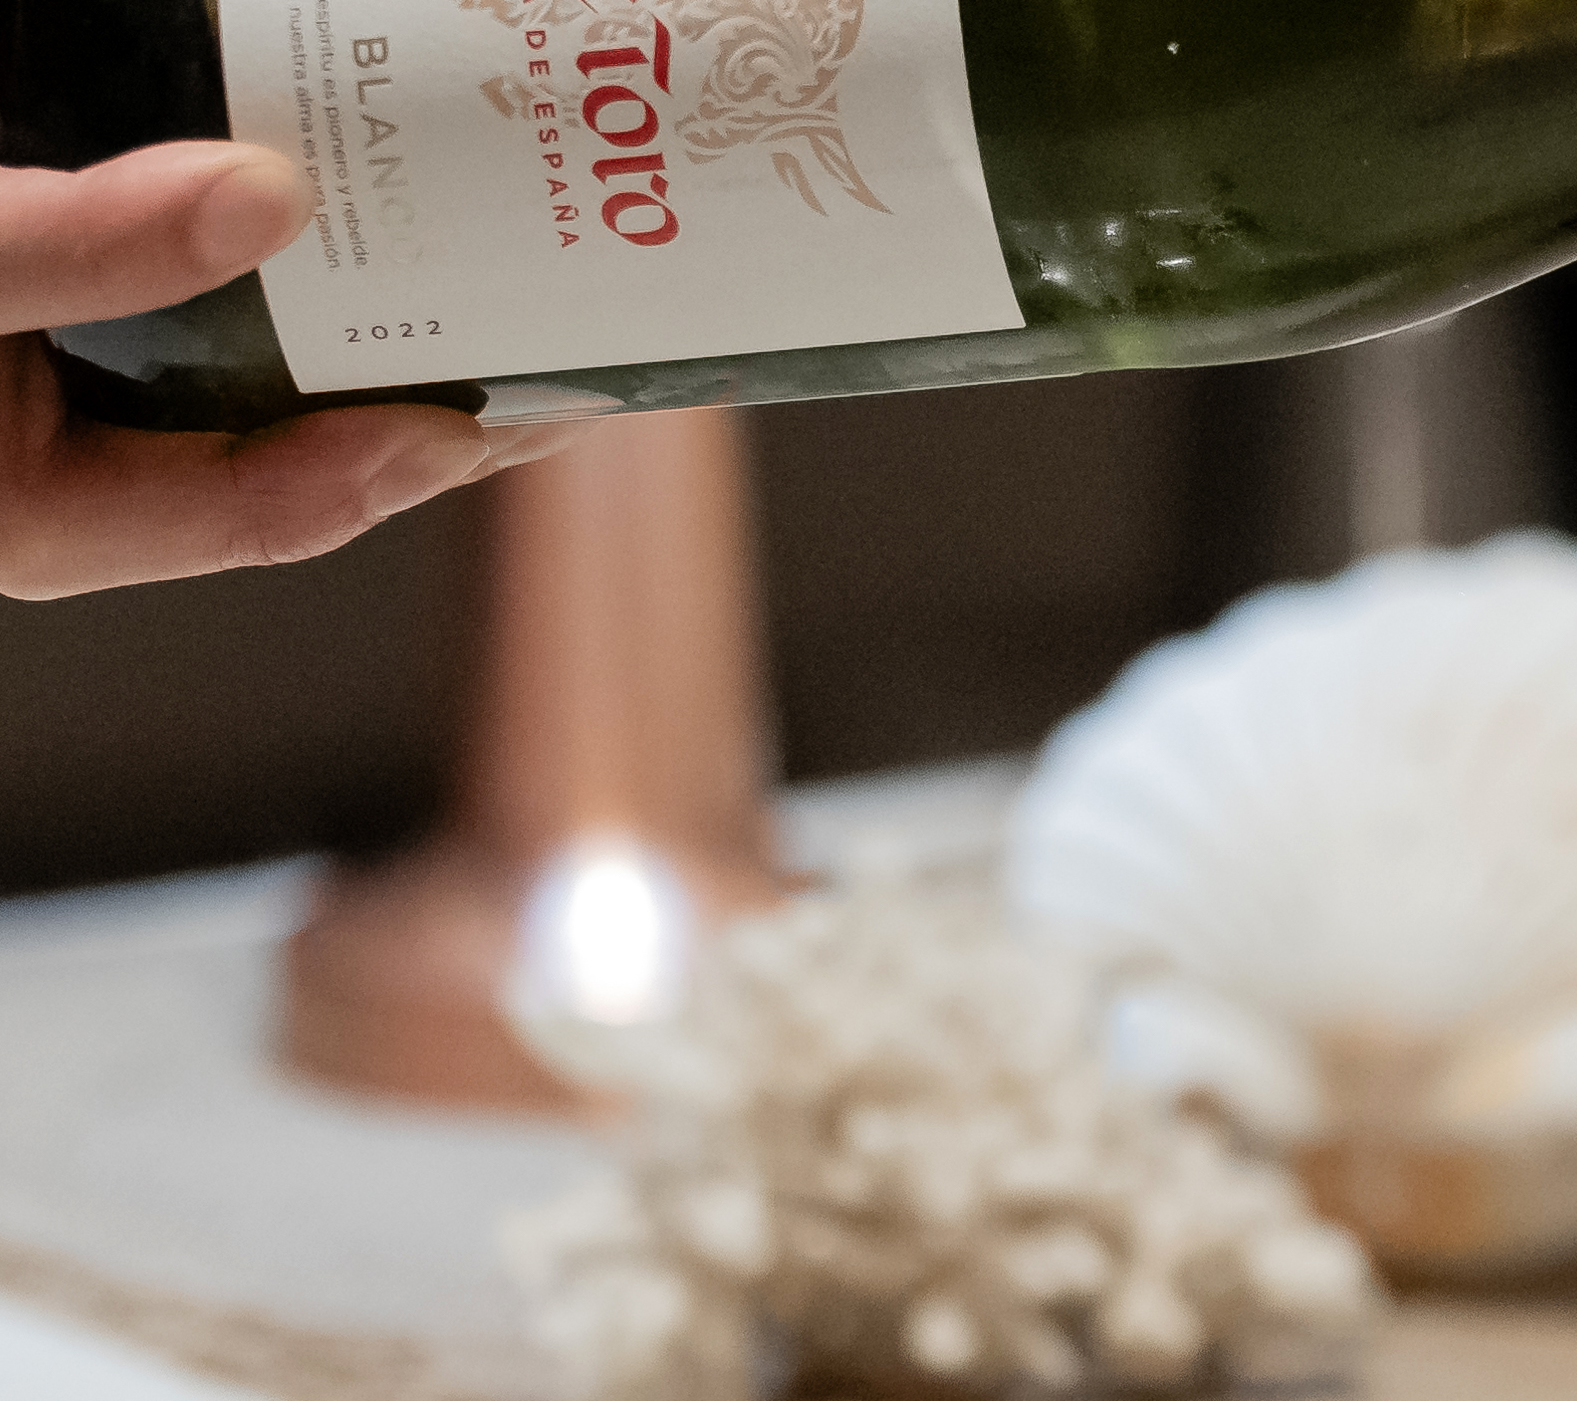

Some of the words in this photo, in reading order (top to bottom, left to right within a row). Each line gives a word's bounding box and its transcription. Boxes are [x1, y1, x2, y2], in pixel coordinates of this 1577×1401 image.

[289, 7, 307, 80] nuestra
[524, 30, 550, 77] DE
[294, 86, 312, 133] alma
[323, 79, 337, 100] es
[303, 138, 318, 160] es
[322, 106, 349, 180] pionero
[575, 12, 680, 247] Toro
[337, 185, 352, 196] y
[533, 102, 580, 250] ESPAÑA
[344, 320, 443, 343] 2022
